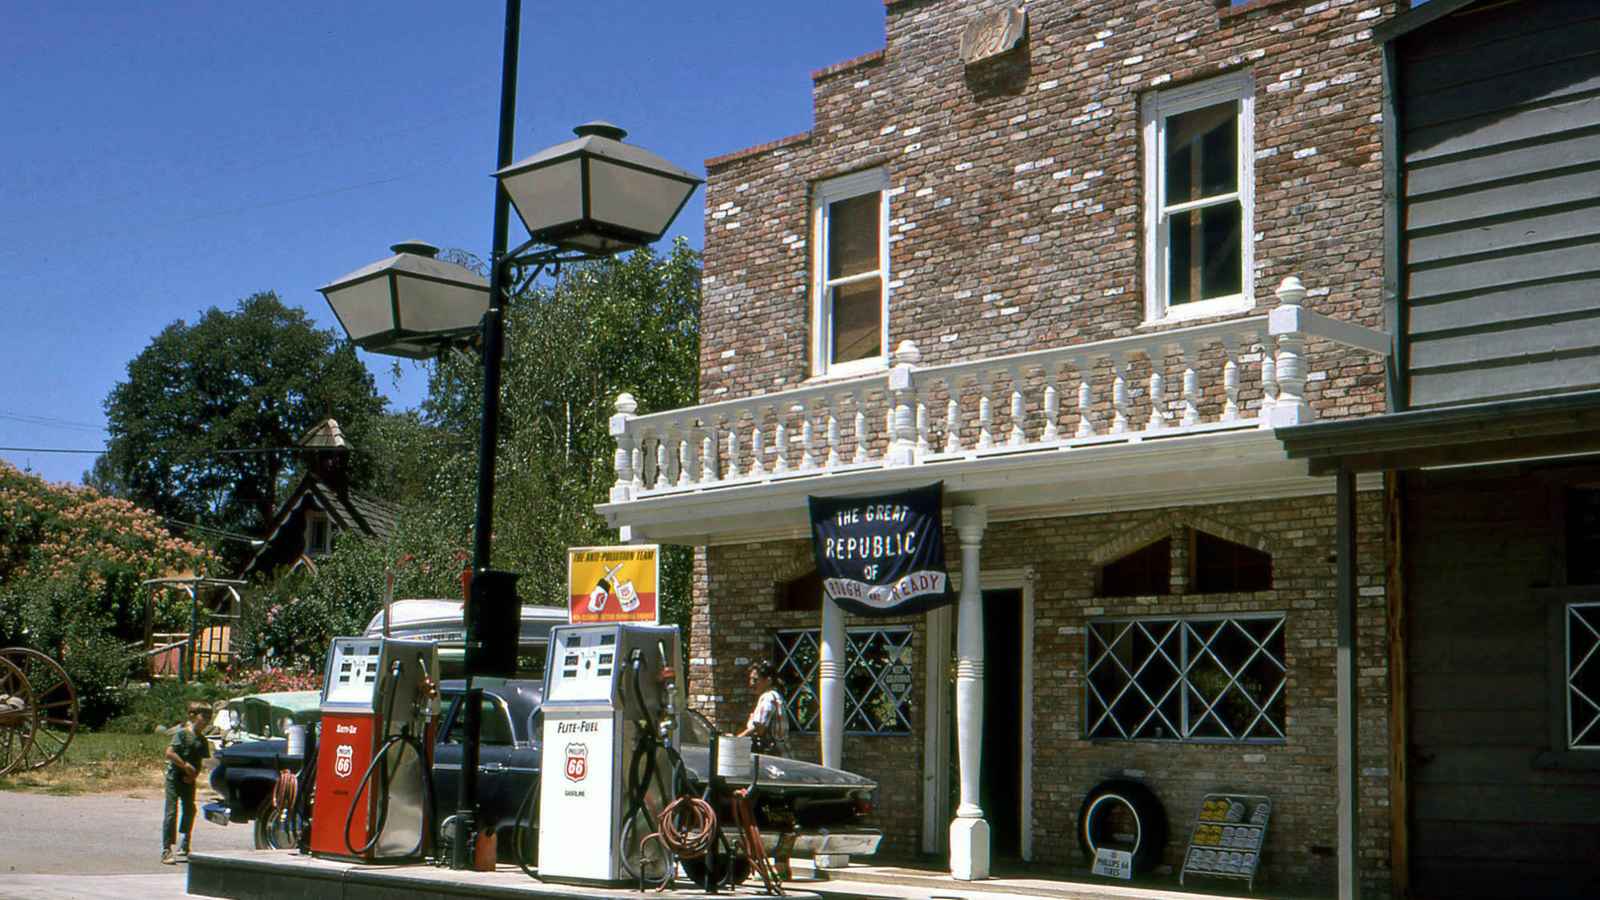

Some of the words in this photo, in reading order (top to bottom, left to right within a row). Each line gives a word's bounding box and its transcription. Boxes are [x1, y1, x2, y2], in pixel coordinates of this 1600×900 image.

[837, 508, 859, 527] THE
[865, 505, 910, 522] GREAT
[825, 531, 916, 559] REPUBLIC
[864, 564, 879, 580] OF
[891, 575, 939, 600] READY
[337, 758, 350, 770] 66
[568, 759, 583, 775] 66
